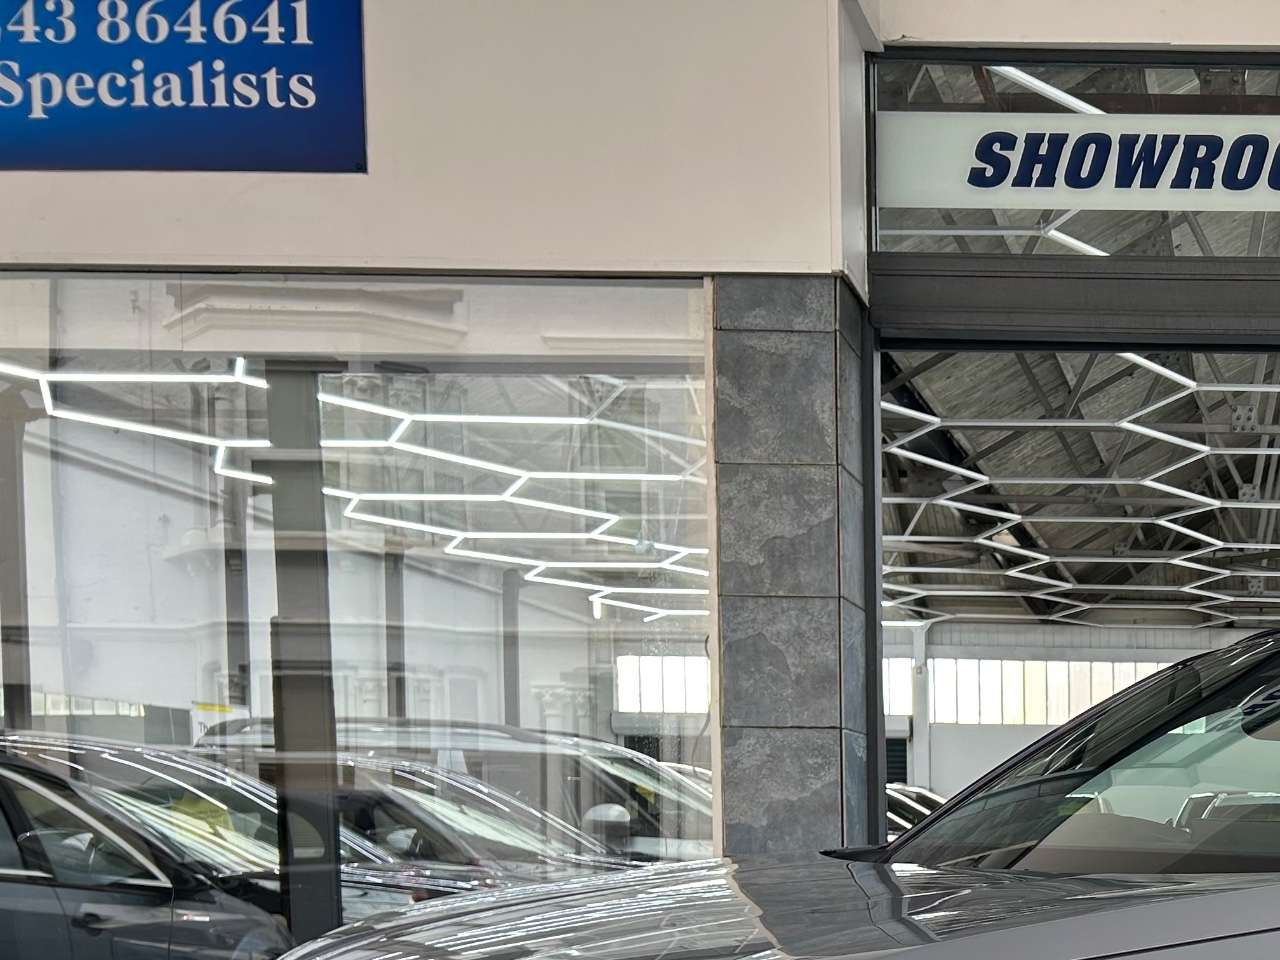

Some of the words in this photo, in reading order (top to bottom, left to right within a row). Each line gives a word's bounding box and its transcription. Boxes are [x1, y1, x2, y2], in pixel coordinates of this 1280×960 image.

[0, 0, 77, 43] 43
[96, 0, 314, 44] 864641
[0, 59, 317, 119] Specialists
